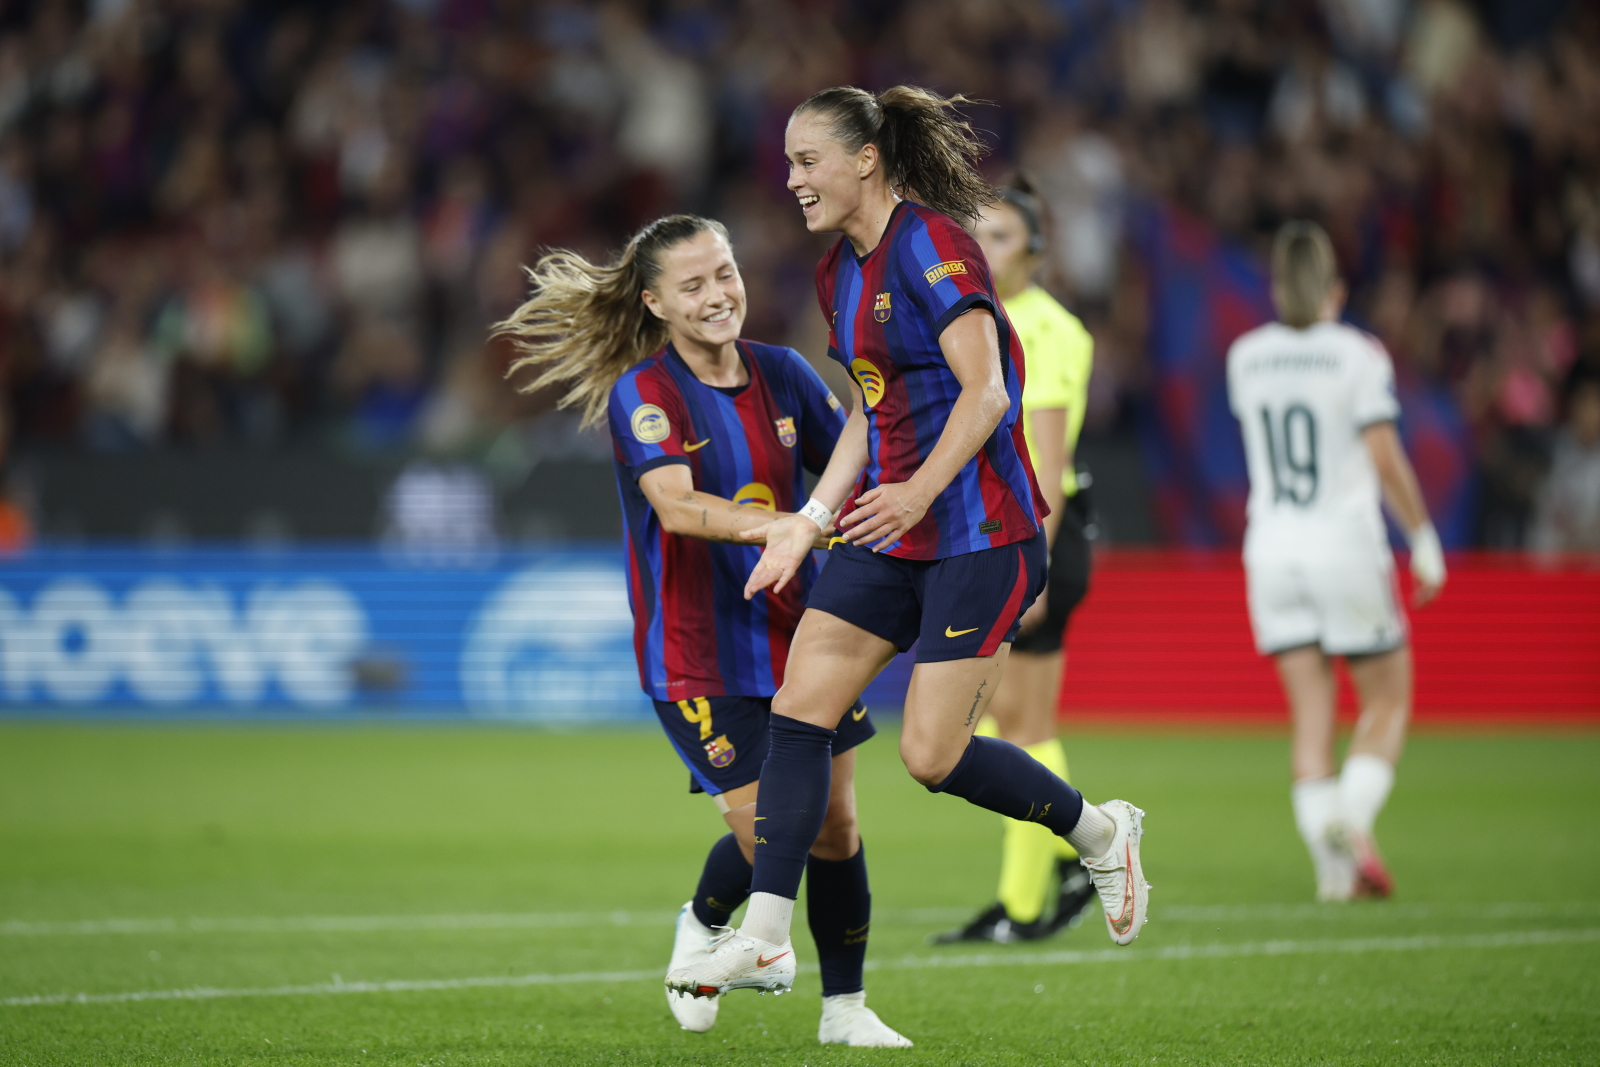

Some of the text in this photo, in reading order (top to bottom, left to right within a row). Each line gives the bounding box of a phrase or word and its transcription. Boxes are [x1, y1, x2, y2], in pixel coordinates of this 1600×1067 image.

[925, 262, 966, 284] BIMBO
[1260, 401, 1319, 508] 19
[0, 576, 369, 706] oeve
[677, 696, 714, 741] 9
